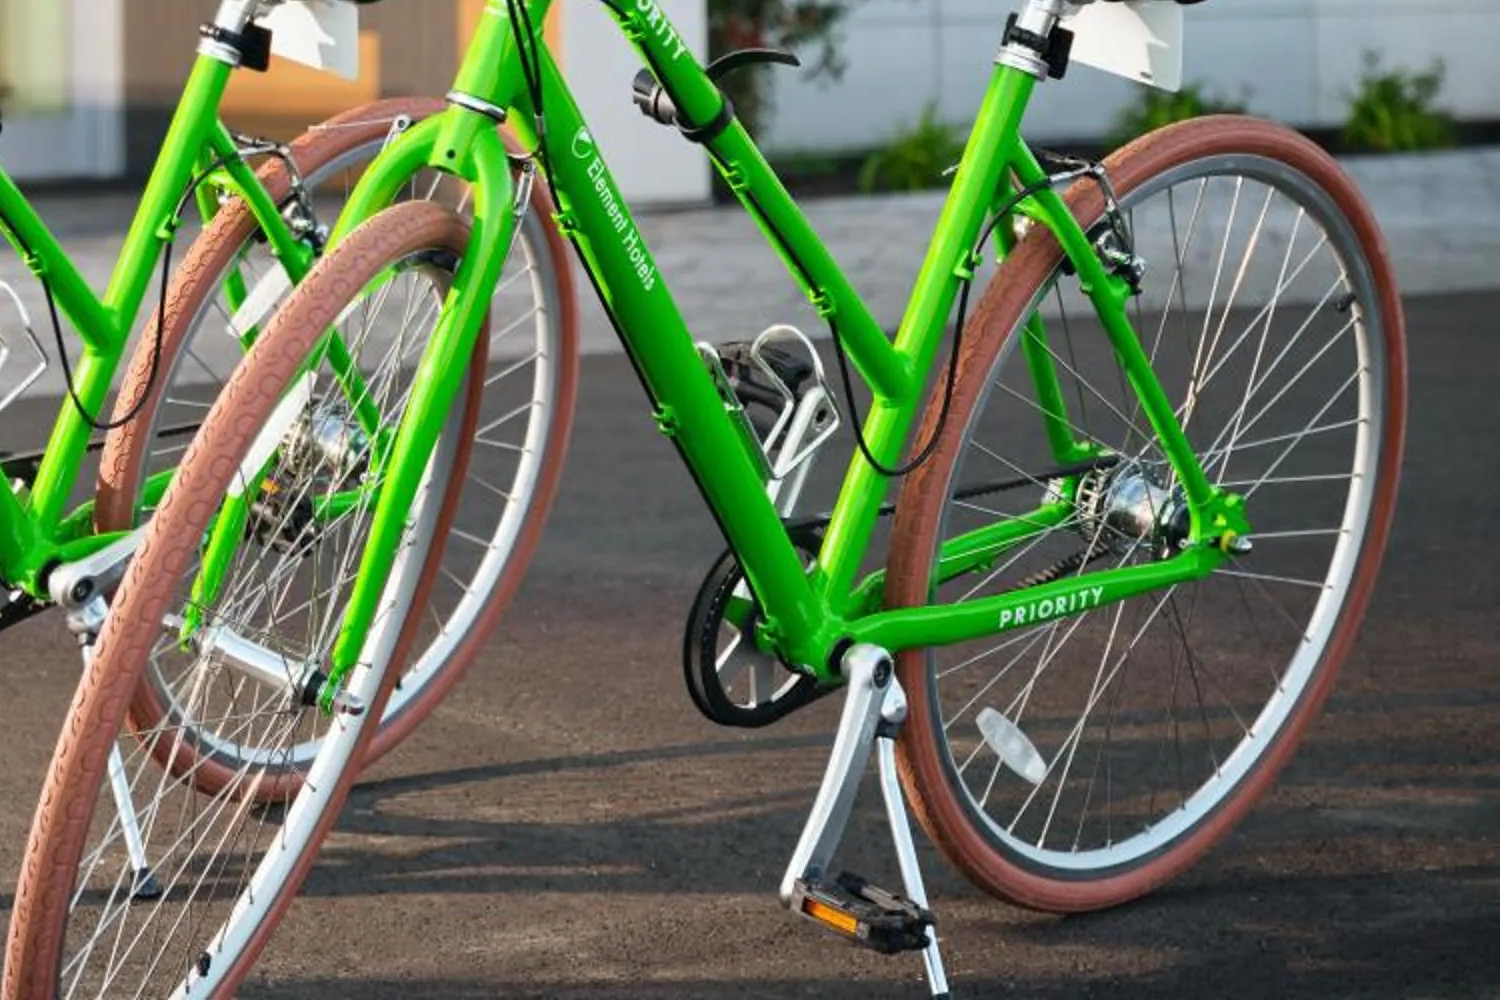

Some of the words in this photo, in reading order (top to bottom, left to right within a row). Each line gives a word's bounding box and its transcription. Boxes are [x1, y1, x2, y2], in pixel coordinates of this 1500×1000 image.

[586, 160, 628, 234] Element
[620, 231, 656, 291] Hotels
[1000, 586, 1103, 629] PRIORITY
